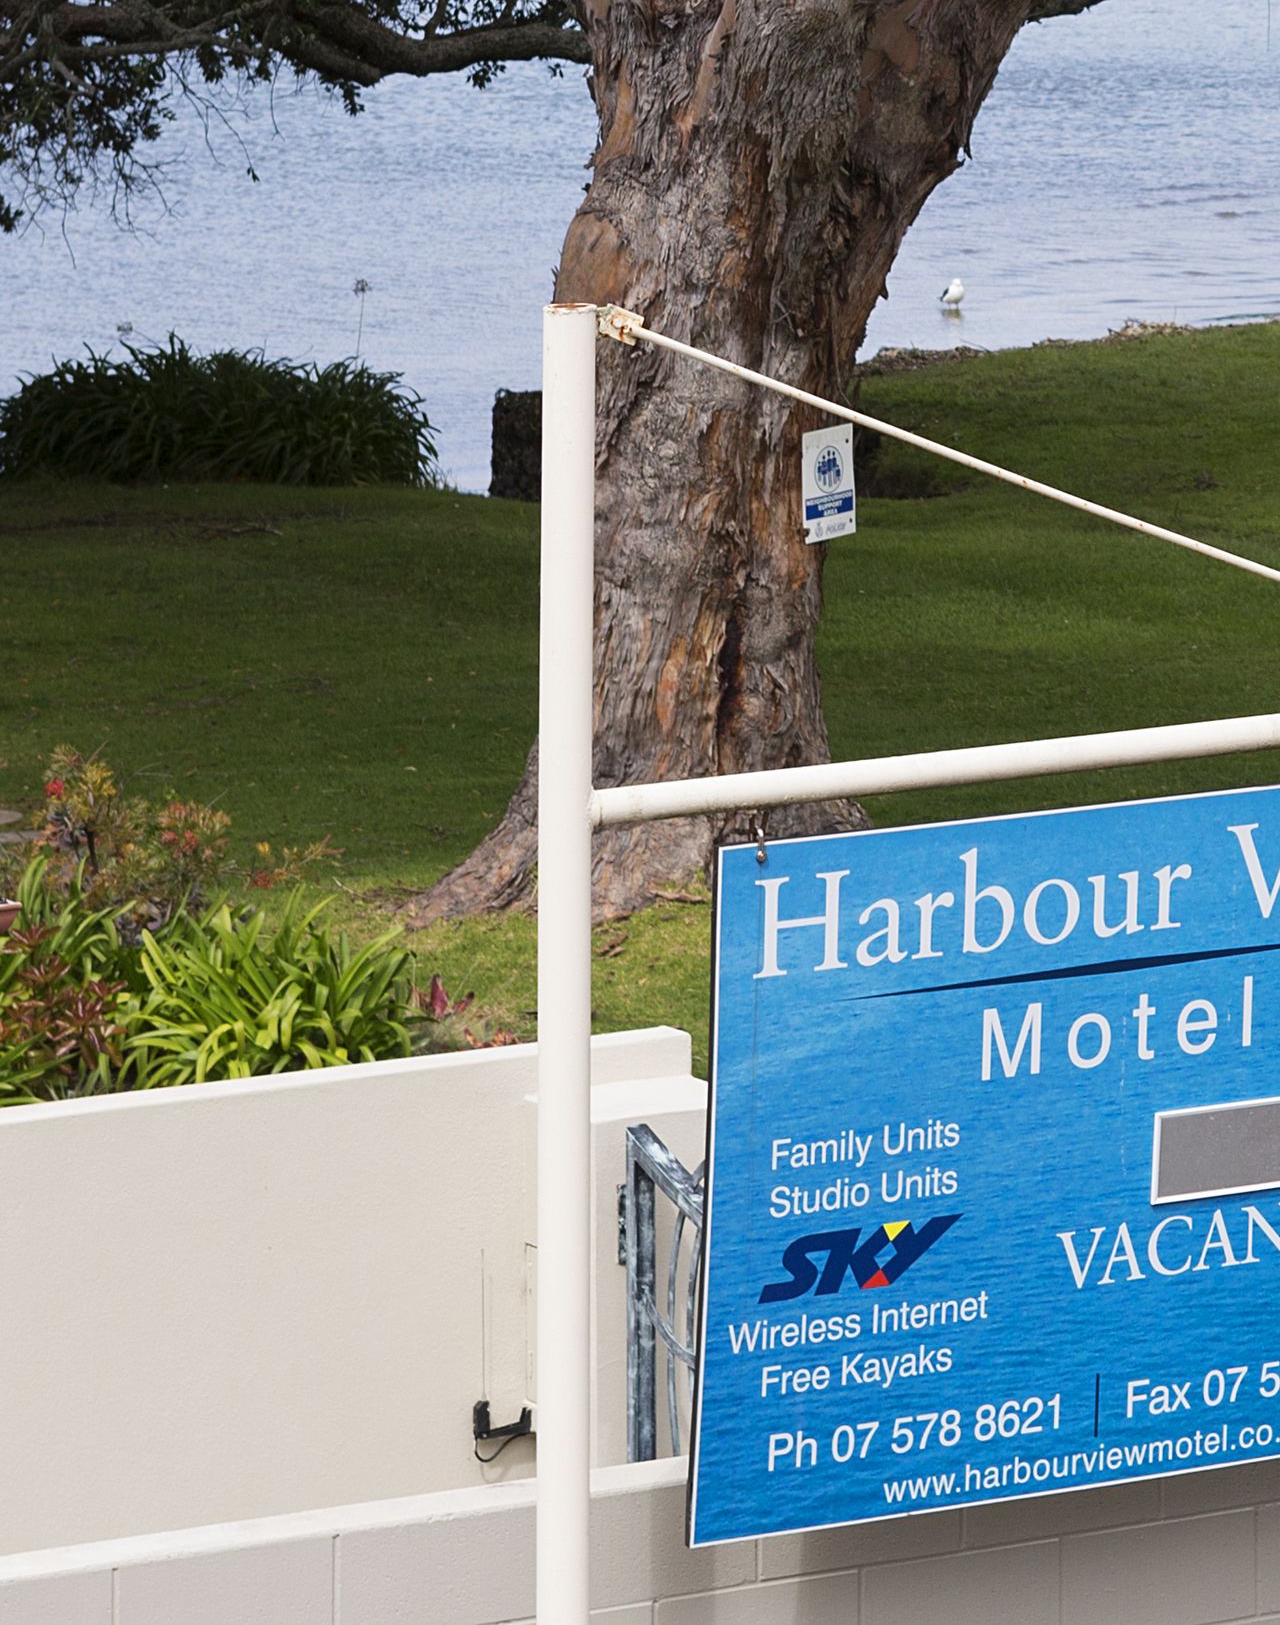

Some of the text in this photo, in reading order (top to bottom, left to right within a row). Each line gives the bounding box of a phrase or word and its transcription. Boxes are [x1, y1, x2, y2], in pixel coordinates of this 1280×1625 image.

[752, 847, 1193, 980] Harbour
[981, 975, 1254, 1082] Motel
[771, 1119, 961, 1171] Family Units
[769, 1166, 959, 1219] Studio Units
[758, 1213, 965, 1305] SKY
[728, 1290, 989, 1355] Wireless Internet
[761, 1344, 953, 1398] Free Kayaks
[1126, 1378, 1192, 1419] Fax
[1202, 1365, 1249, 1407] 07
[767, 1393, 1062, 1472] Ph 07 578 8621
